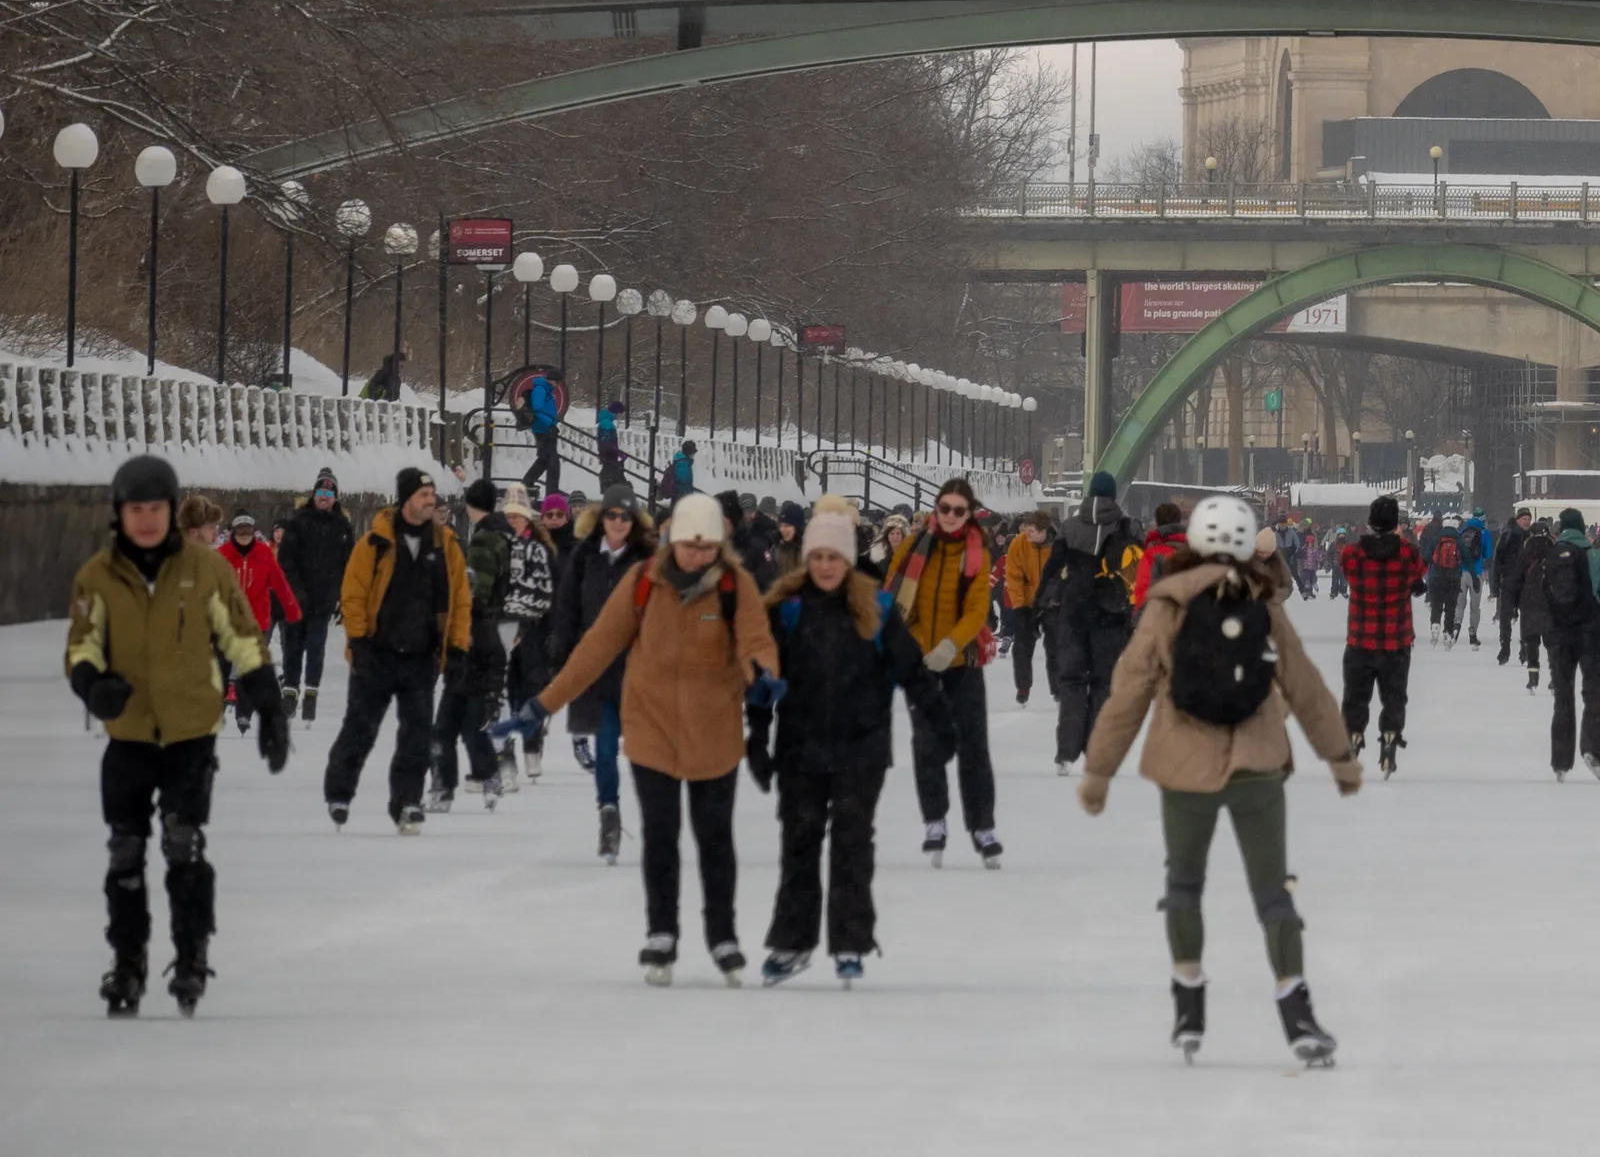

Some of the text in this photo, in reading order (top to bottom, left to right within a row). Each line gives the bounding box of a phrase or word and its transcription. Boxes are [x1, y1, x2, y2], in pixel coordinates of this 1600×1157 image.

[456, 248, 504, 257] SOMERSET
[1144, 282, 1158, 291] the
[1192, 282, 1222, 292] largest
[1223, 282, 1255, 292] skating
[1144, 309, 1152, 317] la
[1153, 309, 1171, 319] plus
[1172, 309, 1203, 319] grande
[1304, 309, 1339, 325] 1971
